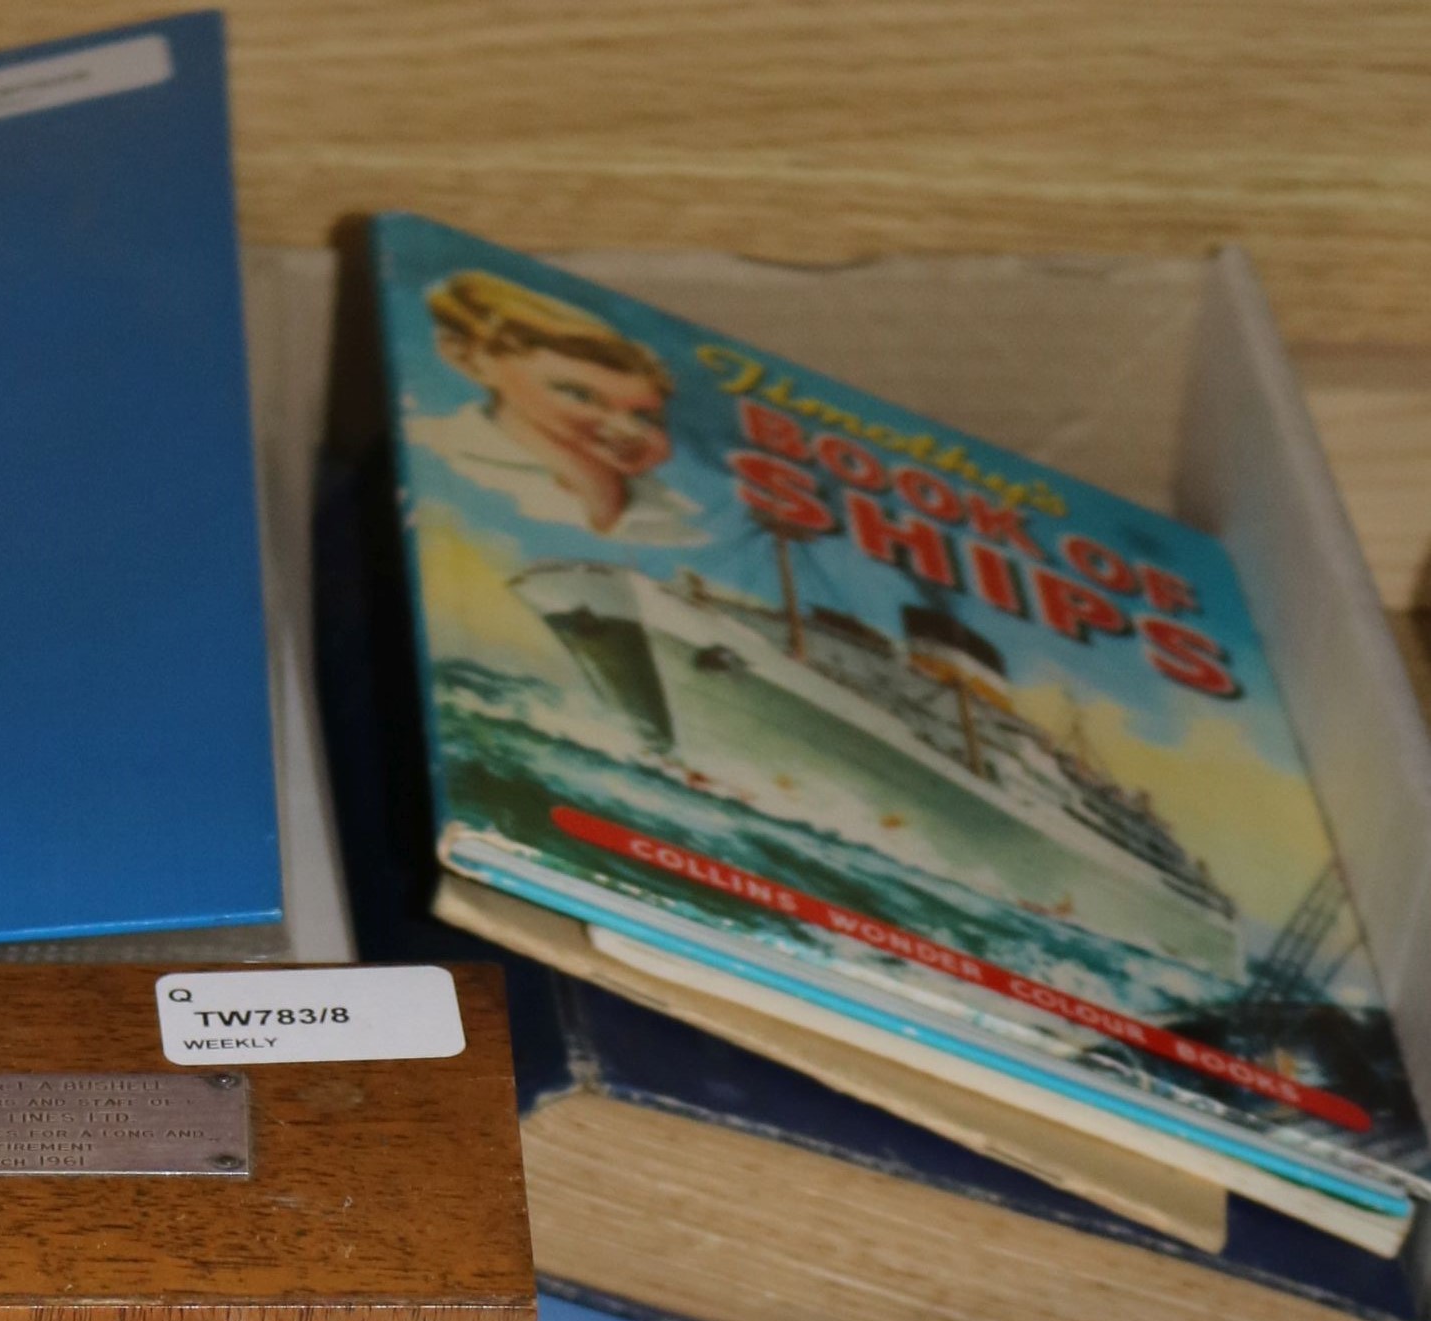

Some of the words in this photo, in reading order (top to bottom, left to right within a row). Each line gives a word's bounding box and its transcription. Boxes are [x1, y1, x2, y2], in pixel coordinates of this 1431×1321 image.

[695, 344, 1066, 517] Timothy's
[739, 400, 1049, 562] BOOK
[1059, 533, 1203, 614] OF
[727, 449, 1243, 700] SHIPS
[629, 838, 800, 914] COLLINS
[827, 906, 985, 980] WONDER
[1009, 978, 1149, 1045] COLOUR
[1174, 1040, 1303, 1102] BOOKS
[169, 989, 193, 1003] Q
[194, 1008, 350, 1027] TW783/8
[184, 1037, 278, 1050] WEEKLY
[28, 1098, 67, 1107] AND
[78, 1098, 137, 1107] STAFF
[9, 1112, 75, 1124] LINES
[30, 1129, 69, 1138] FOR
[166, 1129, 205, 1138] AND
[39, 1154, 86, 1167] 1961
